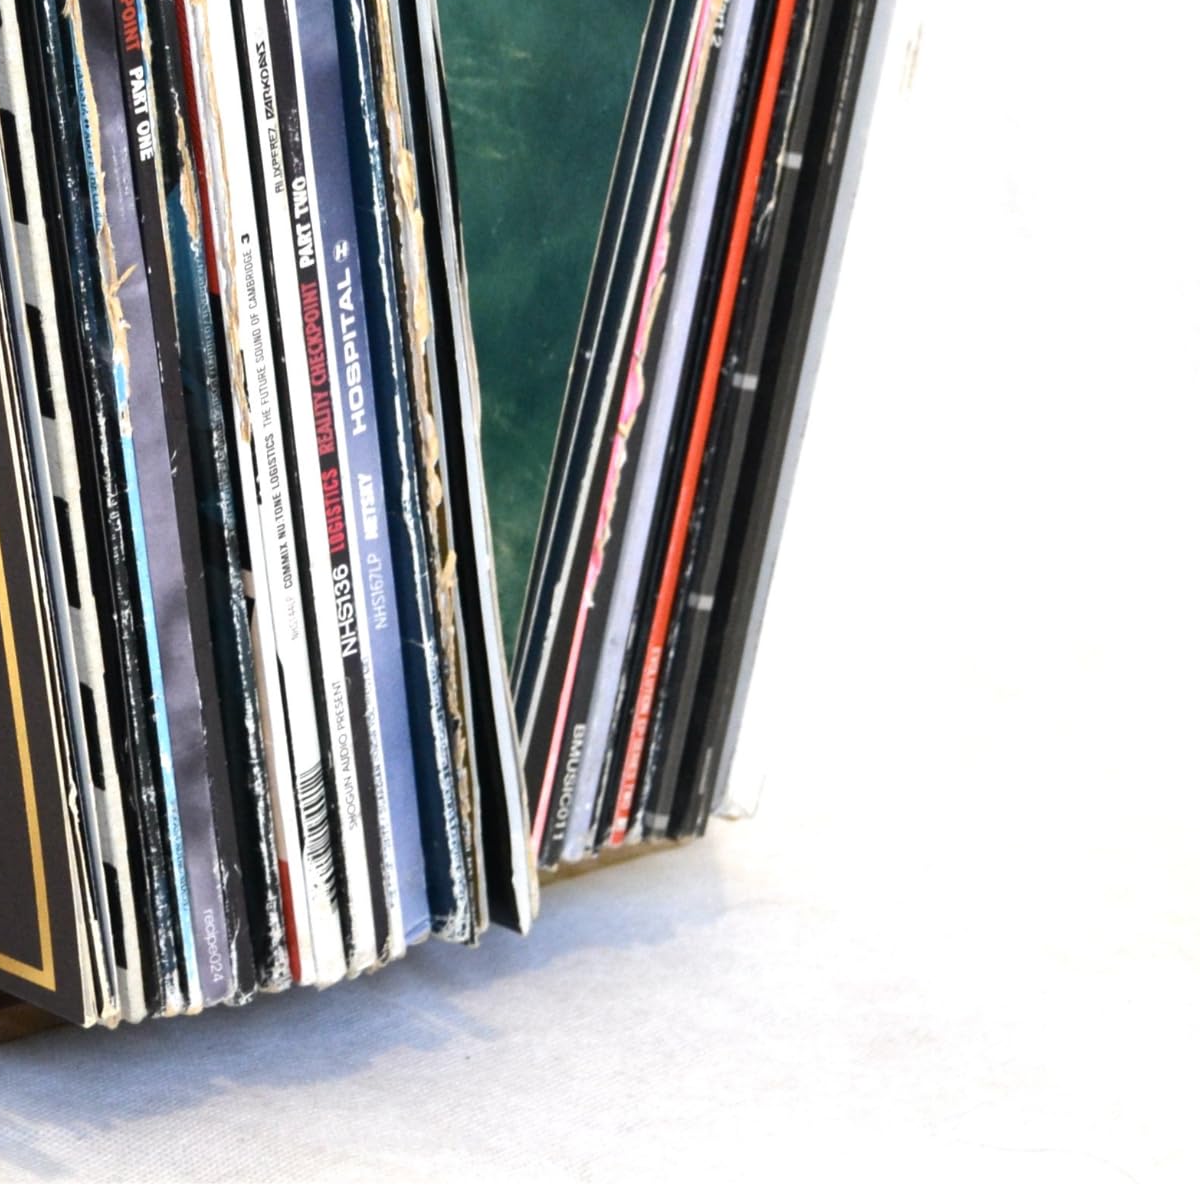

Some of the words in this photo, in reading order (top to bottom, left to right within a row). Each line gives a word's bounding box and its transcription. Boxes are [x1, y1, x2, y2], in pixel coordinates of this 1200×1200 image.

[129, 65, 149, 114] PART
[136, 119, 155, 163] ONE
[291, 175, 309, 218] TWO
[241, 232, 250, 244] 3
[294, 222, 315, 269] PART
[245, 249, 260, 309] CAMBRIDGE
[251, 311, 262, 327] OF
[301, 280, 327, 386] CHECKPOINT
[253, 327, 266, 364] SOUND
[337, 267, 367, 436] HOSPITAL
[258, 364, 271, 406] FUTURE
[262, 407, 273, 428] THE
[314, 392, 335, 456] REALITY
[264, 432, 281, 490] LOGISTICS
[322, 467, 345, 553] LOGISTICS
[278, 541, 294, 590] COMMIX
[333, 563, 358, 657] NHS136
[366, 553, 388, 630] NHS167LP
[332, 680, 348, 731] PRESENT
[339, 732, 351, 773] AUDIO
[345, 775, 359, 831] SHOGUN
[551, 722, 586, 843] BMUSIC011
[202, 908, 224, 982] recipe024
